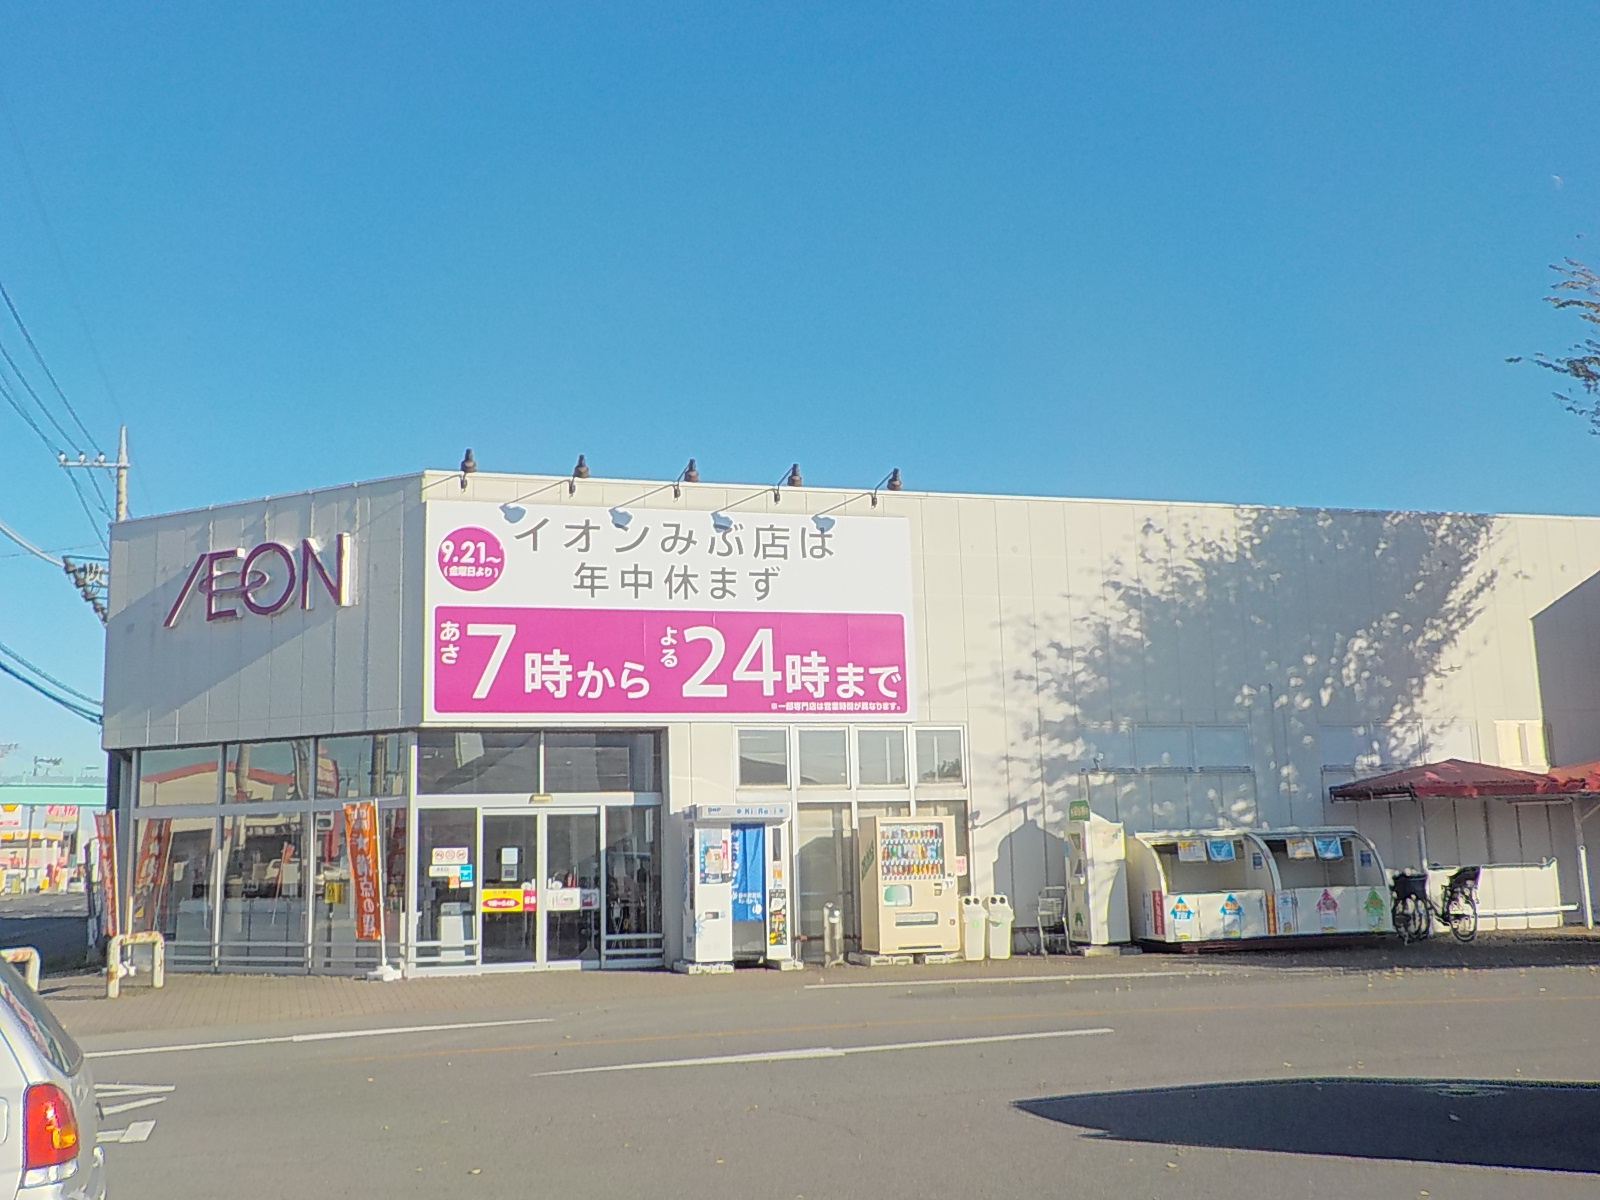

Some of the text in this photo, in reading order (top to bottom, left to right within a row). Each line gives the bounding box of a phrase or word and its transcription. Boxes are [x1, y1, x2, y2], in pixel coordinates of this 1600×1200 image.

[514, 517, 834, 560] イオンみぶ店は
[573, 562, 781, 601] 年中休まず
[440, 621, 460, 664] あさ
[466, 623, 650, 699] 7時から
[660, 626, 678, 668] よる
[682, 626, 902, 699] 24時まで
